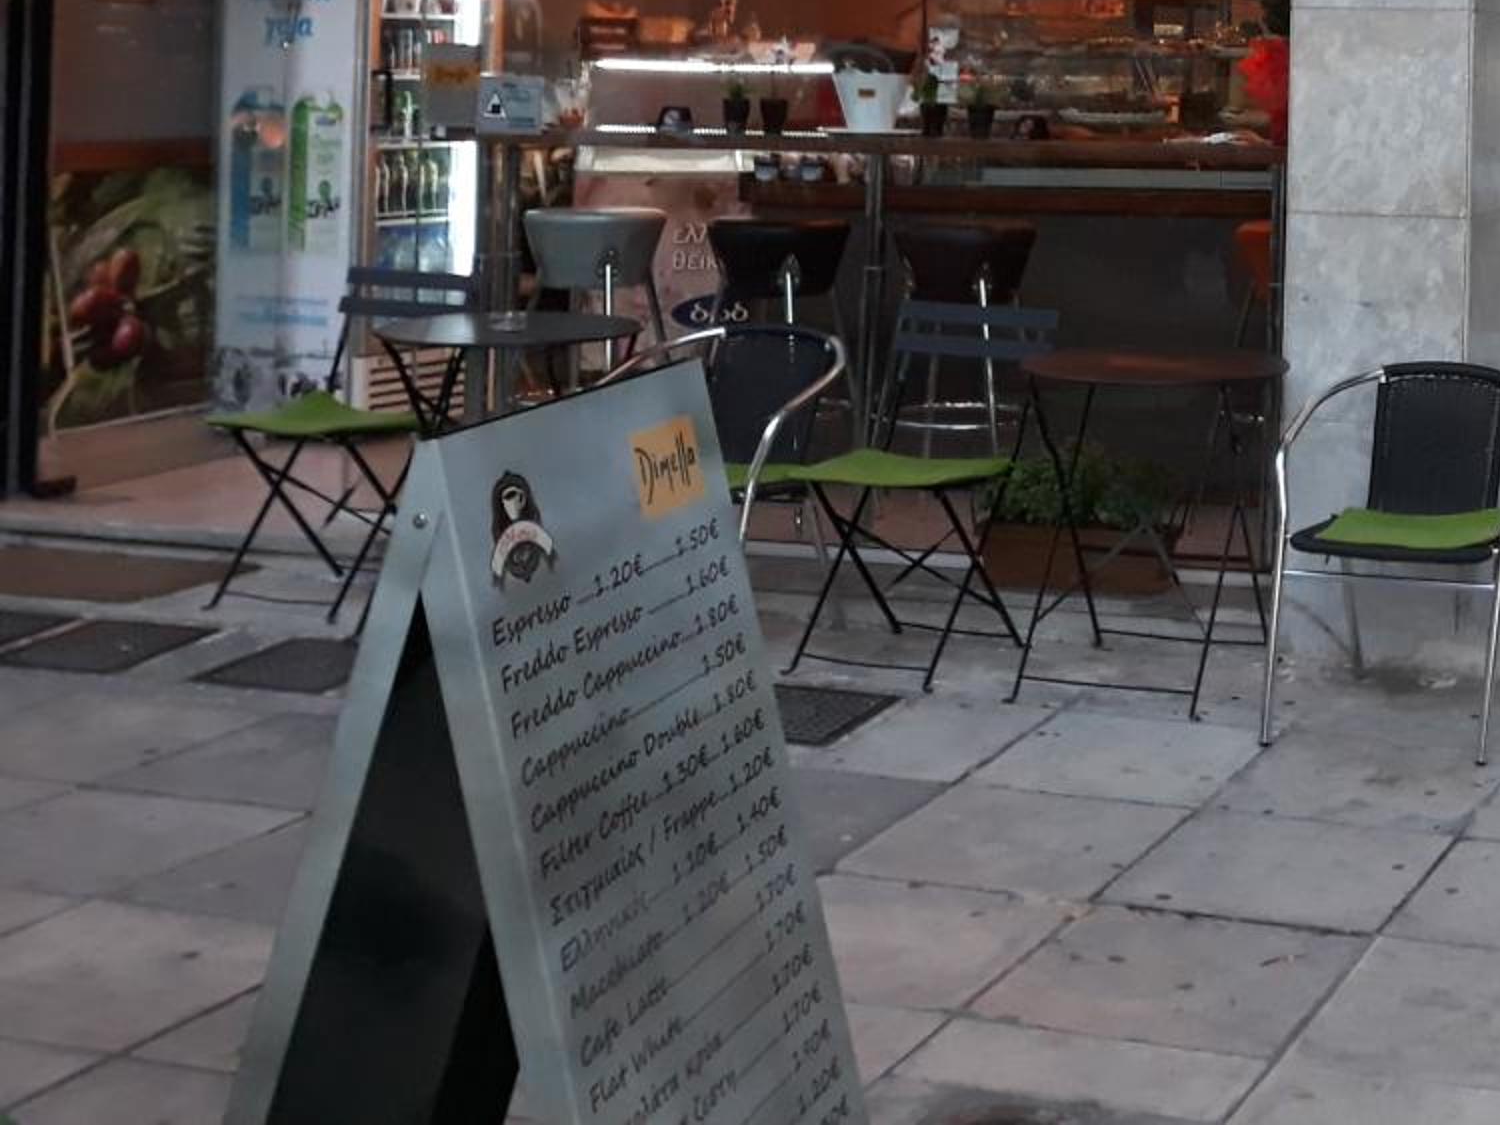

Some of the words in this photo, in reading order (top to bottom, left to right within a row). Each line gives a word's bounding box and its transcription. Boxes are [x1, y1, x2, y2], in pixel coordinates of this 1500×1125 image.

[492, 595, 571, 646] Espresso
[501, 638, 569, 693] Freddo
[573, 606, 643, 654] Espresso
[511, 686, 578, 739] Freddo
